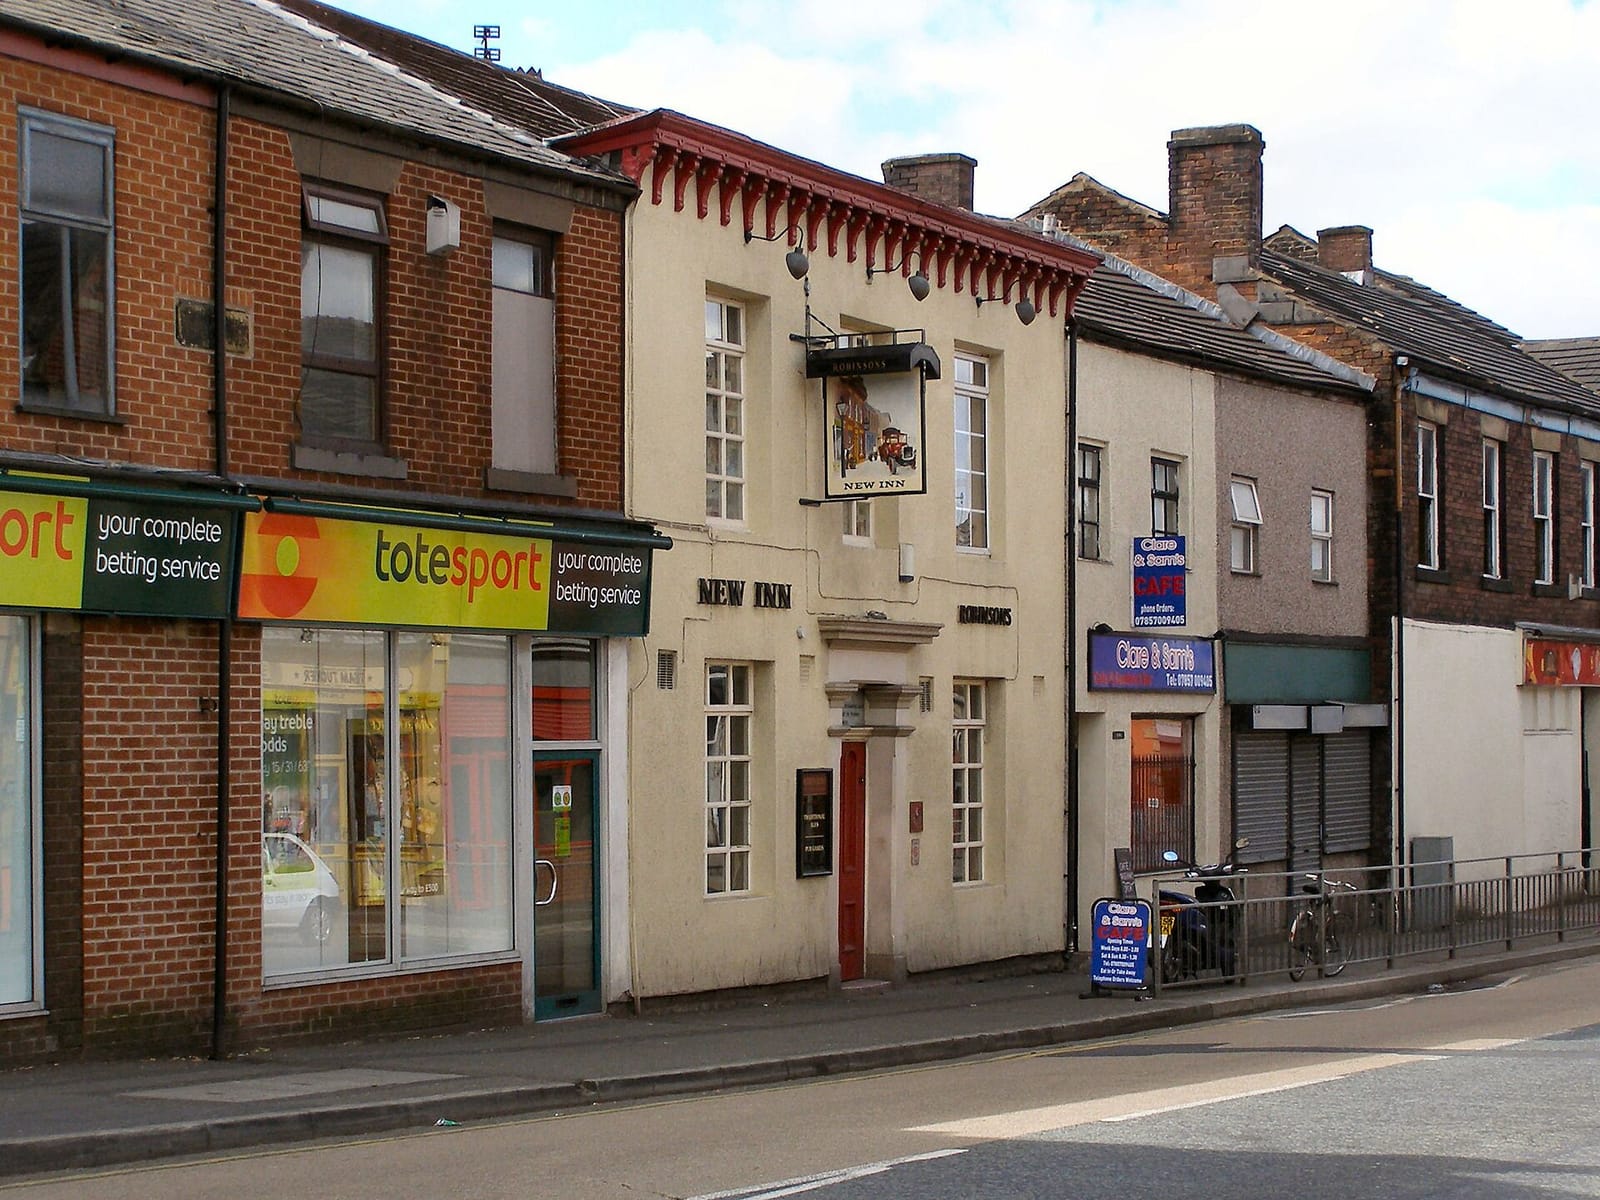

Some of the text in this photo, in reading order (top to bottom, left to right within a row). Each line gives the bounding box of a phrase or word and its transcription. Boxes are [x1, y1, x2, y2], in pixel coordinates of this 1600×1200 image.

[832, 360, 886, 371] ROBINSONS
[844, 479, 905, 491] NEW INN
[0, 501, 74, 560] ort
[98, 514, 222, 544] your complete
[1141, 538, 1177, 551] Clare
[96, 547, 221, 583] betting service
[375, 529, 543, 604] totesport
[558, 552, 642, 577] your complete
[1134, 554, 1185, 567] & Sam's
[556, 580, 641, 608] betting service
[697, 578, 793, 609] NEW INN
[1134, 575, 1184, 596] CAFE
[957, 604, 1013, 627] ROBINSONS
[1141, 604, 1156, 614] phone
[1116, 640, 1194, 671] Clare & Sam's
[1166, 673, 1177, 686] Tel:
[280, 713, 313, 730] treble
[1107, 903, 1137, 915] Clare
[1101, 915, 1111, 926] &
[1097, 927, 1144, 940] CAFE
